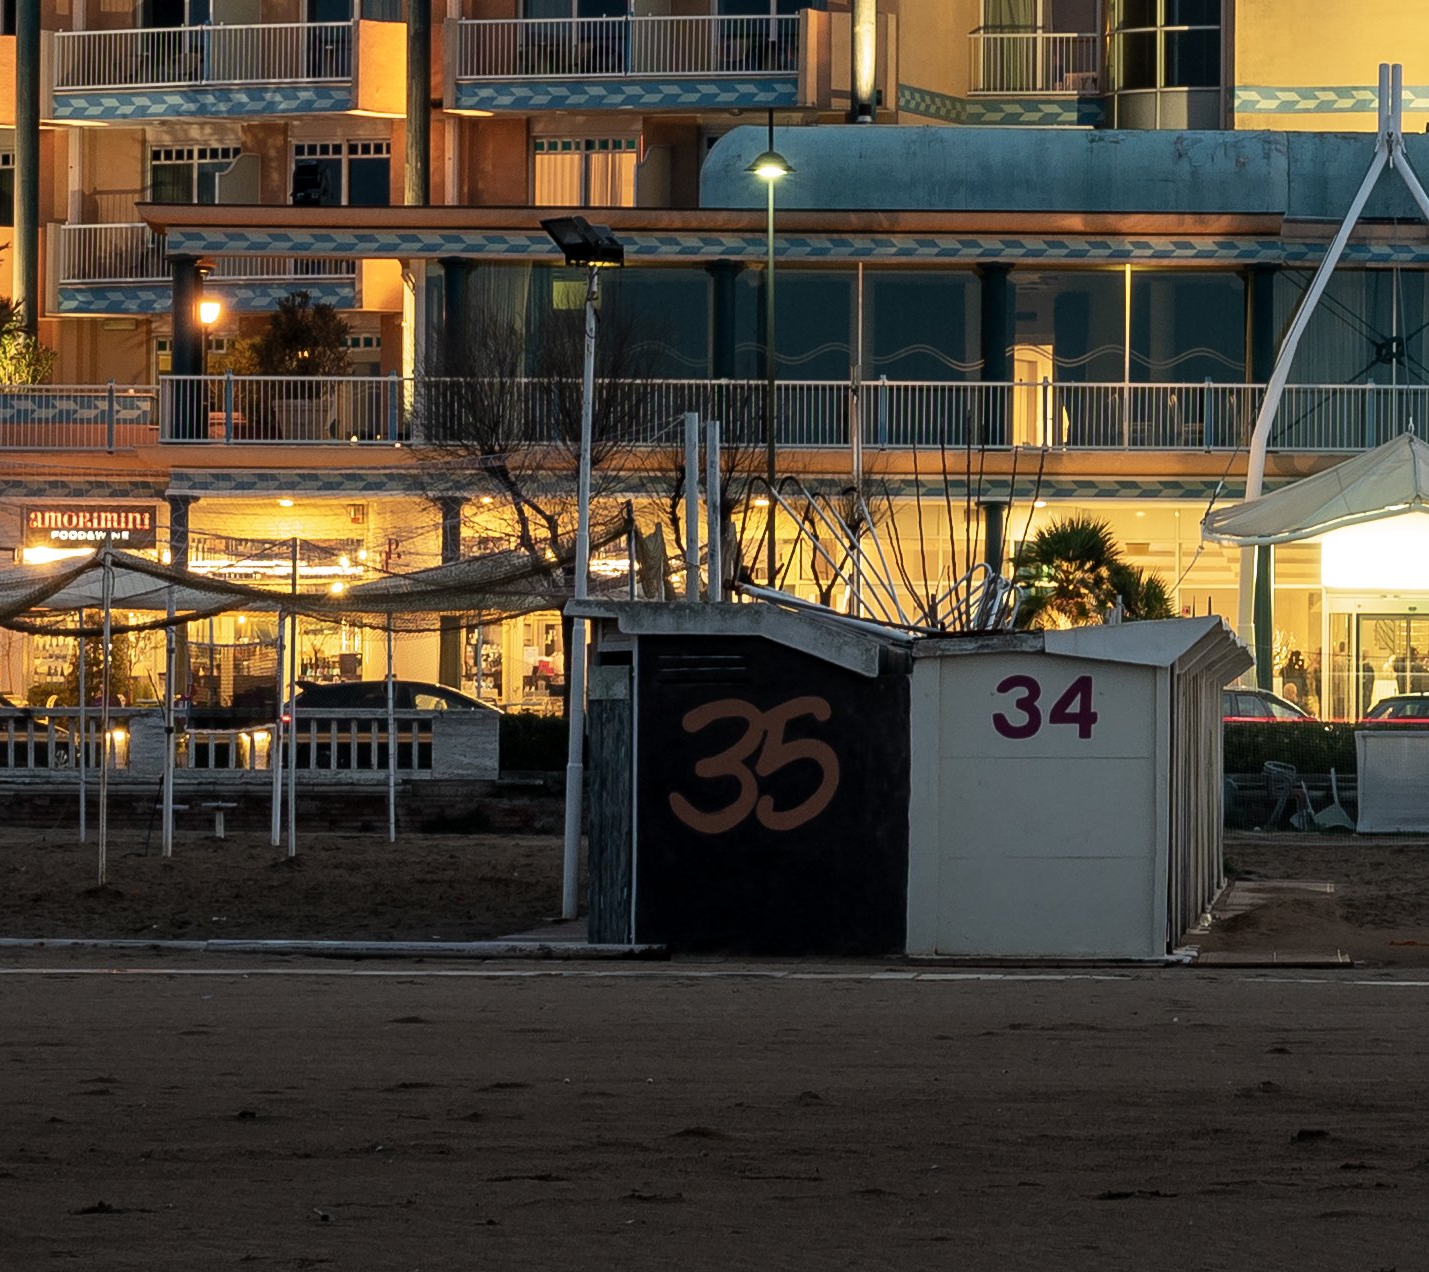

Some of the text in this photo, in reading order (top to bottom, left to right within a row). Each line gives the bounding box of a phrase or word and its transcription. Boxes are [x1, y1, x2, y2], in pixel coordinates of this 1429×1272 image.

[51, 530, 129, 540] FOOD&WNE
[992, 674, 1098, 739] 34
[669, 695, 840, 835] 35
